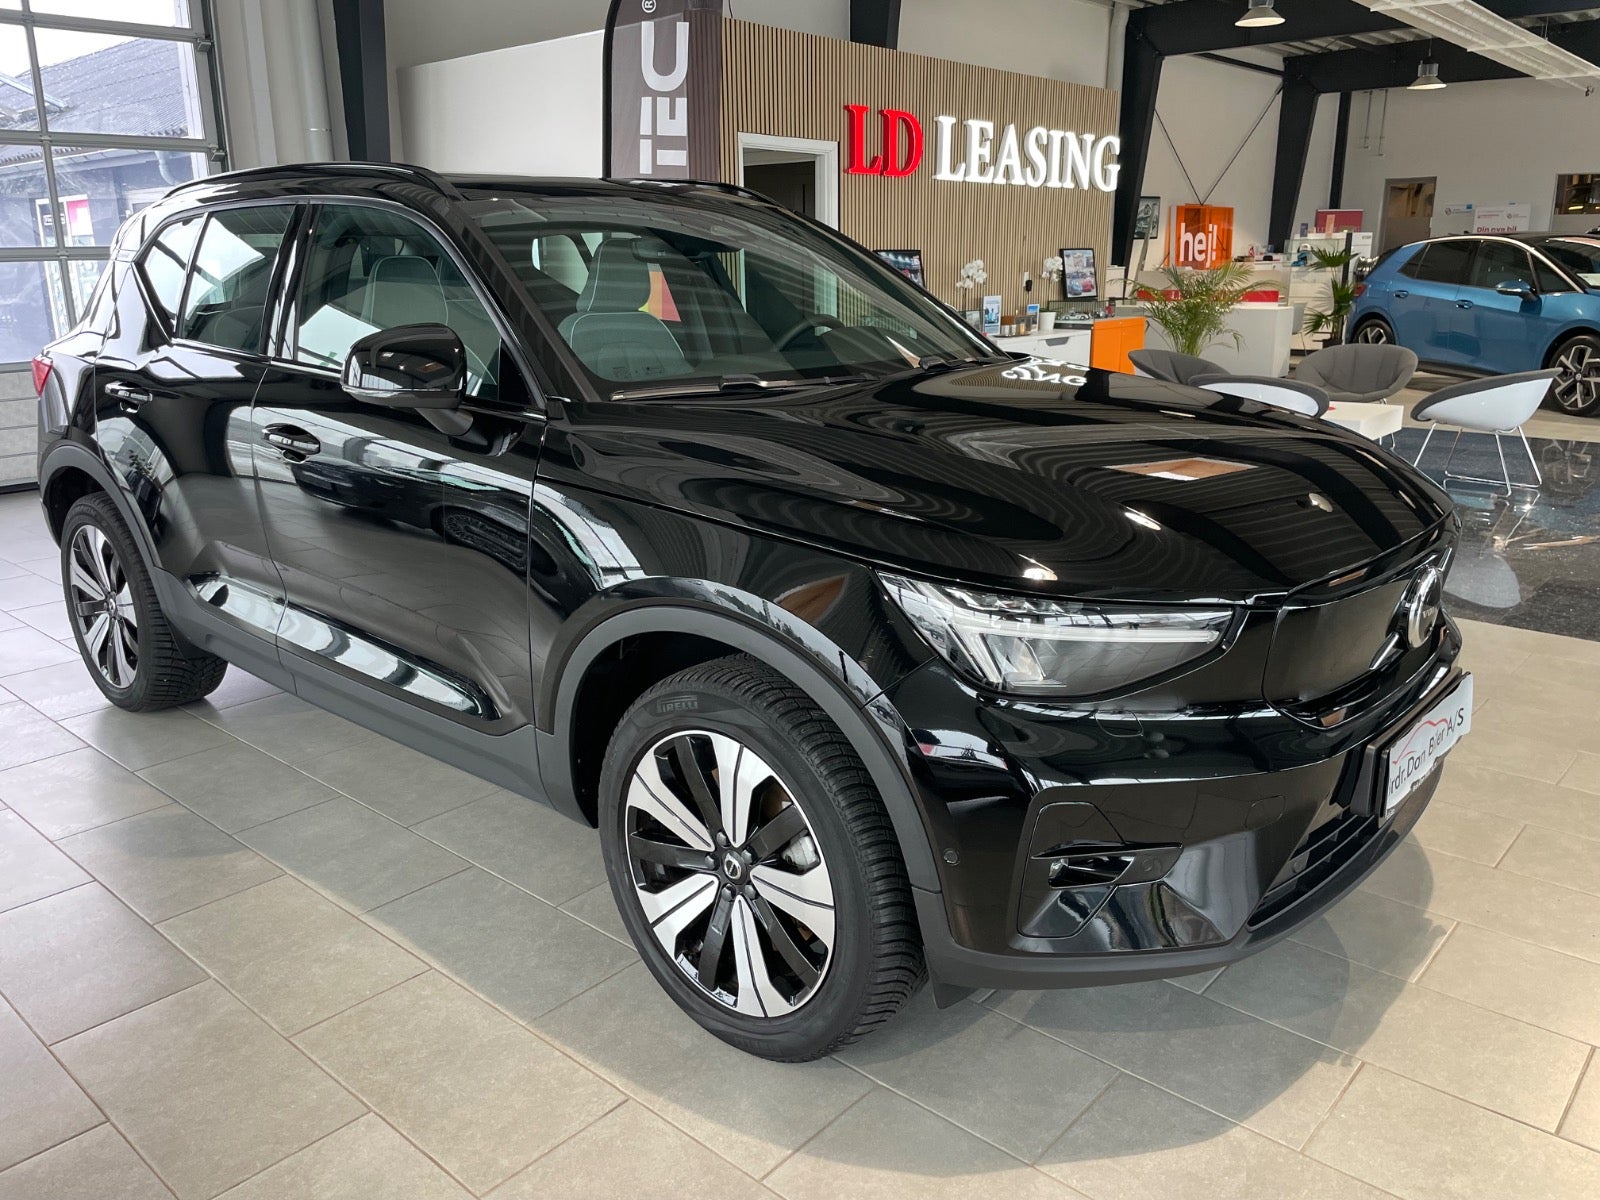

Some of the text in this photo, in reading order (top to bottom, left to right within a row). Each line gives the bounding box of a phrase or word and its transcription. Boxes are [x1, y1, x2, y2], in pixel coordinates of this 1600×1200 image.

[844, 103, 1121, 193] LD LEASING
[1179, 222, 1218, 269] hej!
[656, 694, 698, 713] PIRELLI
[1446, 707, 1465, 737] A/S
